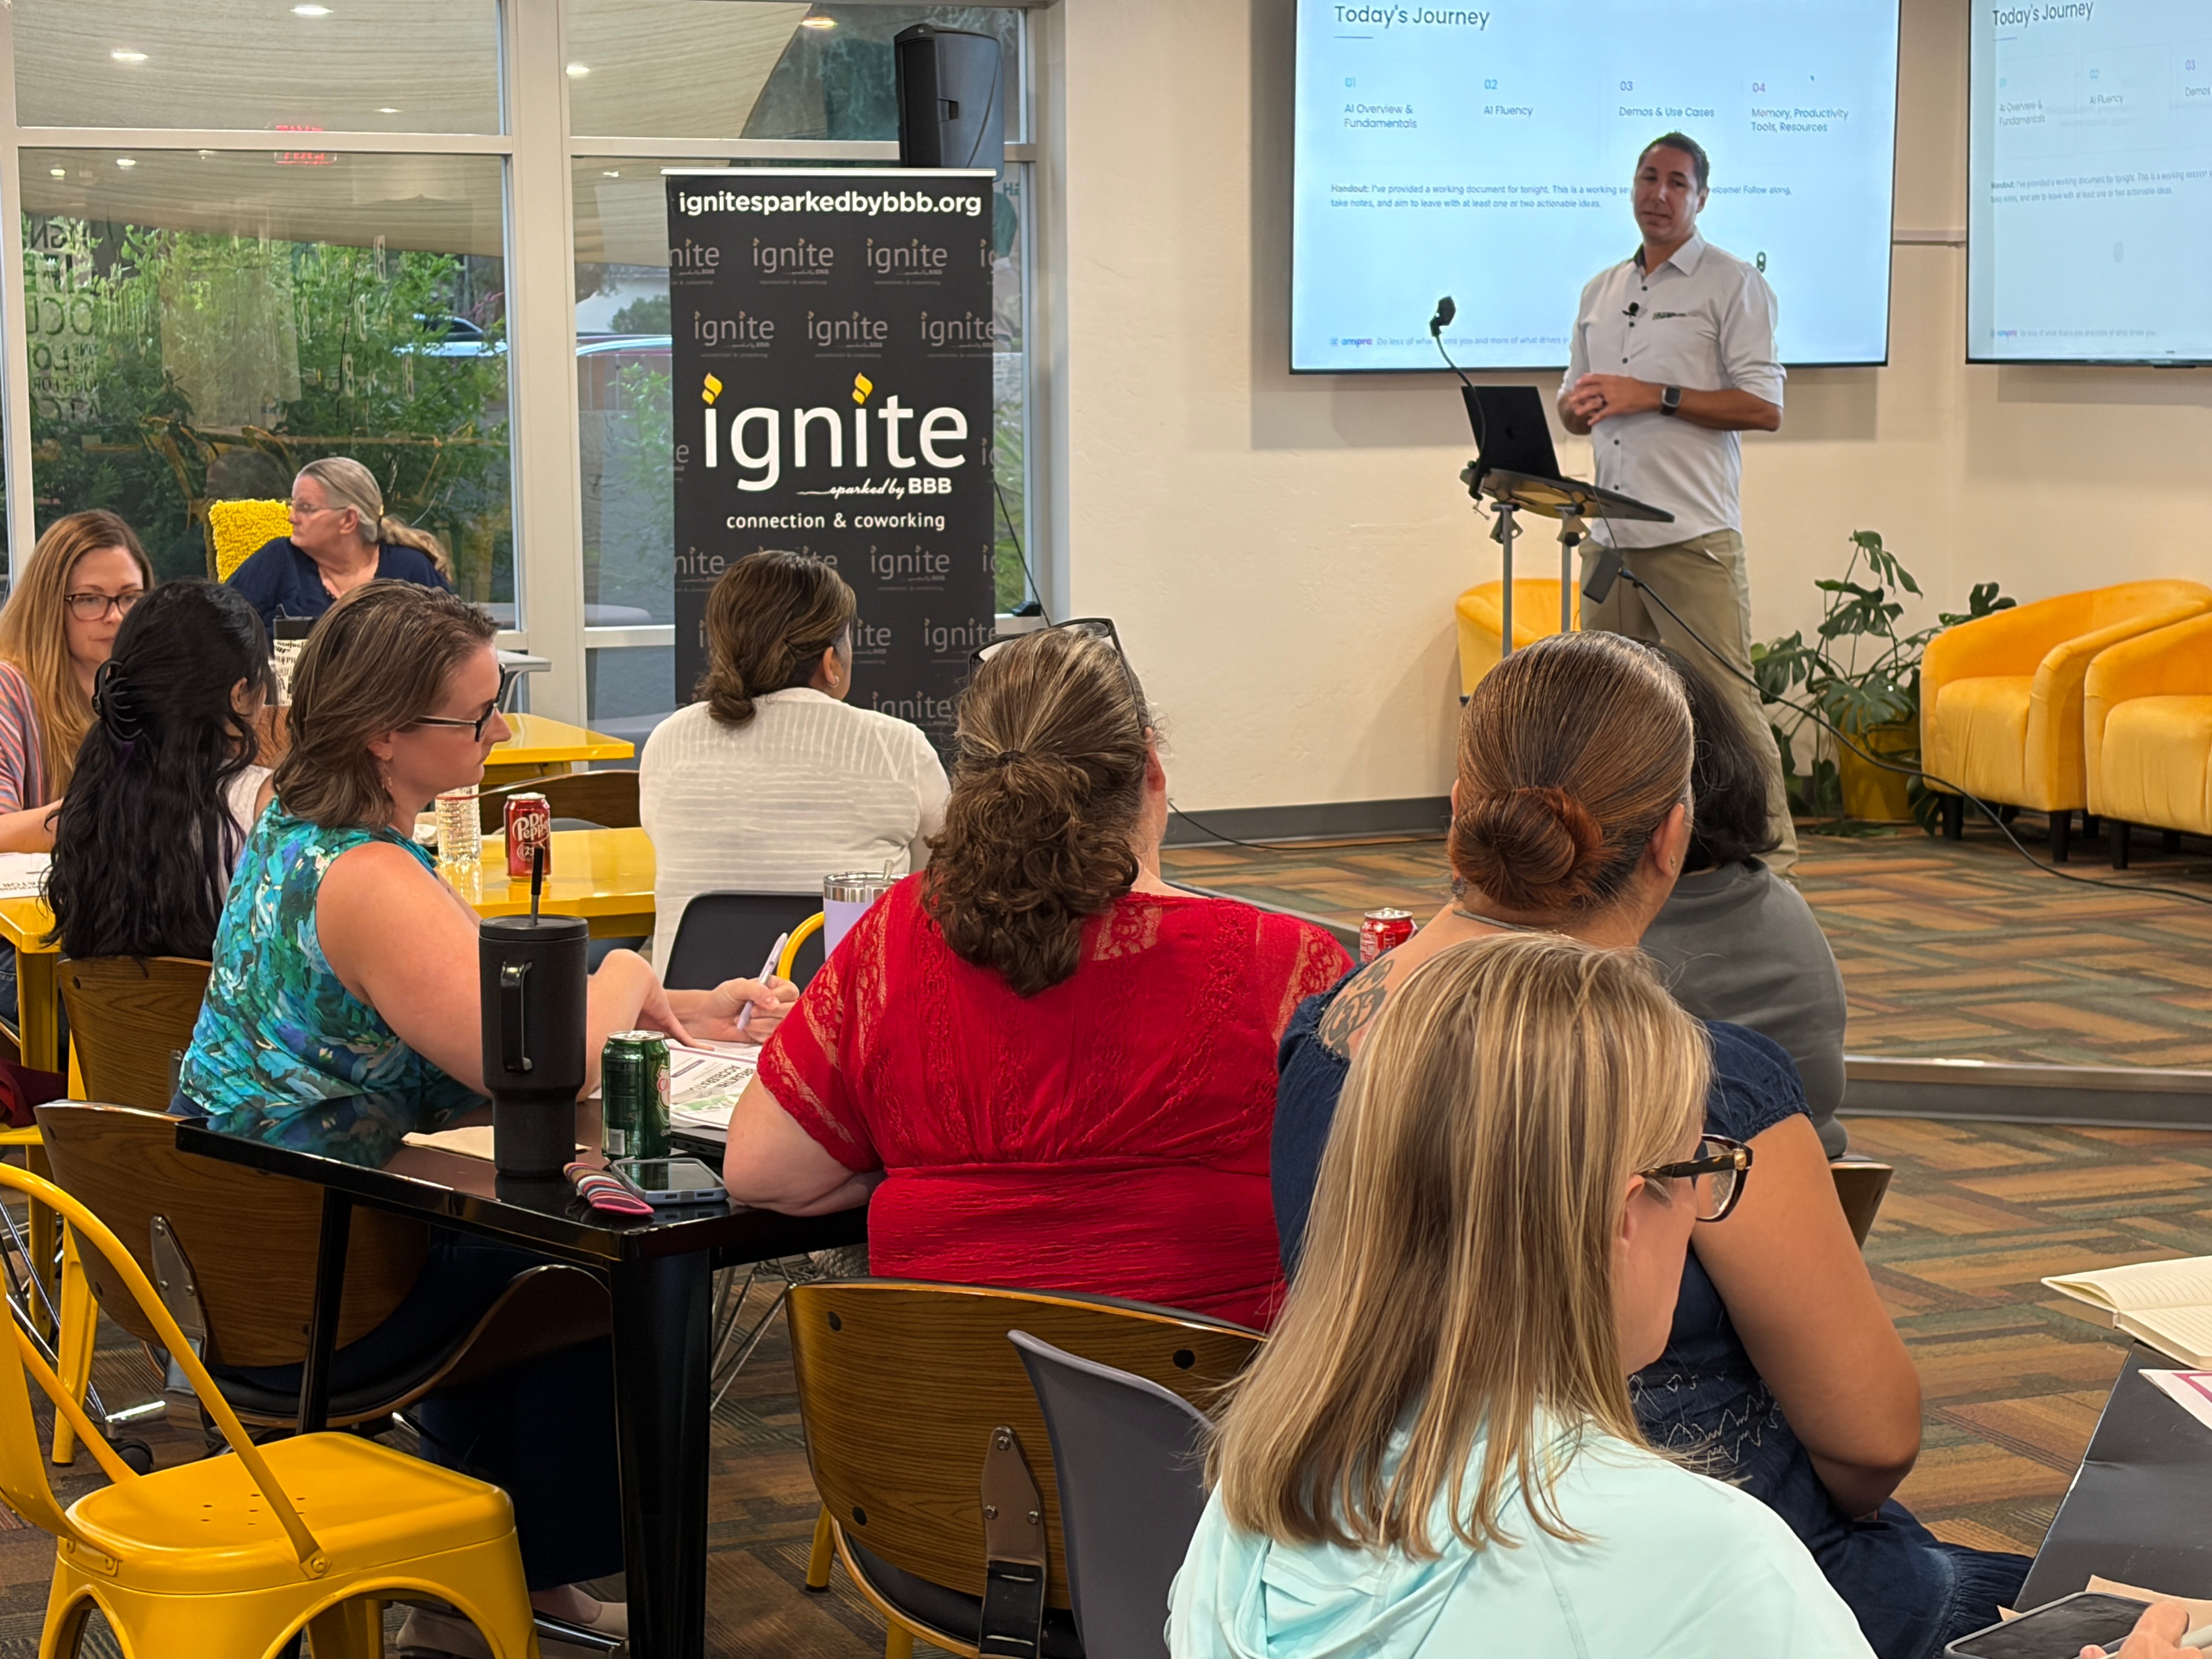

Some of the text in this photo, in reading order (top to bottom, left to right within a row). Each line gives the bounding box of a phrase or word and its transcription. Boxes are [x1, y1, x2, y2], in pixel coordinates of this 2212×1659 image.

[1335, 5, 1490, 31] Today's Journey
[1993, 2, 2094, 28] Today's Journey
[2186, 59, 2196, 70] 03
[1345, 77, 1356, 88] 01
[1484, 80, 1498, 89] 02
[1620, 81, 1633, 91] 03
[1752, 83, 1765, 93] 04
[2185, 86, 2210, 97] Demos
[1344, 103, 1413, 115] AI Overview &
[1484, 105, 1533, 117] AI Fluency
[1619, 107, 1715, 117] Demos & Use Cases
[1752, 108, 1849, 120] Memory, Productivity
[1344, 119, 1417, 128] Fundamentals
[1751, 122, 1828, 133] Tools, Resources
[1389, 185, 1423, 194] provided
[1432, 185, 1464, 195] working
[1586, 185, 1617, 195] working
[1711, 186, 1741, 194] elcome!
[679, 191, 981, 216] ignitesparkedbybbb.org
[1537, 200, 1577, 208] actionable
[669, 238, 720, 267] nite
[753, 237, 834, 273] ignite
[867, 238, 948, 273] ignite
[694, 311, 775, 346] ignite
[808, 311, 888, 346] ignite
[702, 373, 968, 490] ignite
[821, 477, 952, 500] sparked by BBB
[726, 512, 945, 531] connection & coworking
[674, 545, 725, 575] nite
[870, 545, 950, 580] ignite
[857, 618, 891, 646] ite
[529, 813, 545, 827] Dr
[516, 817, 550, 842] Peppe
